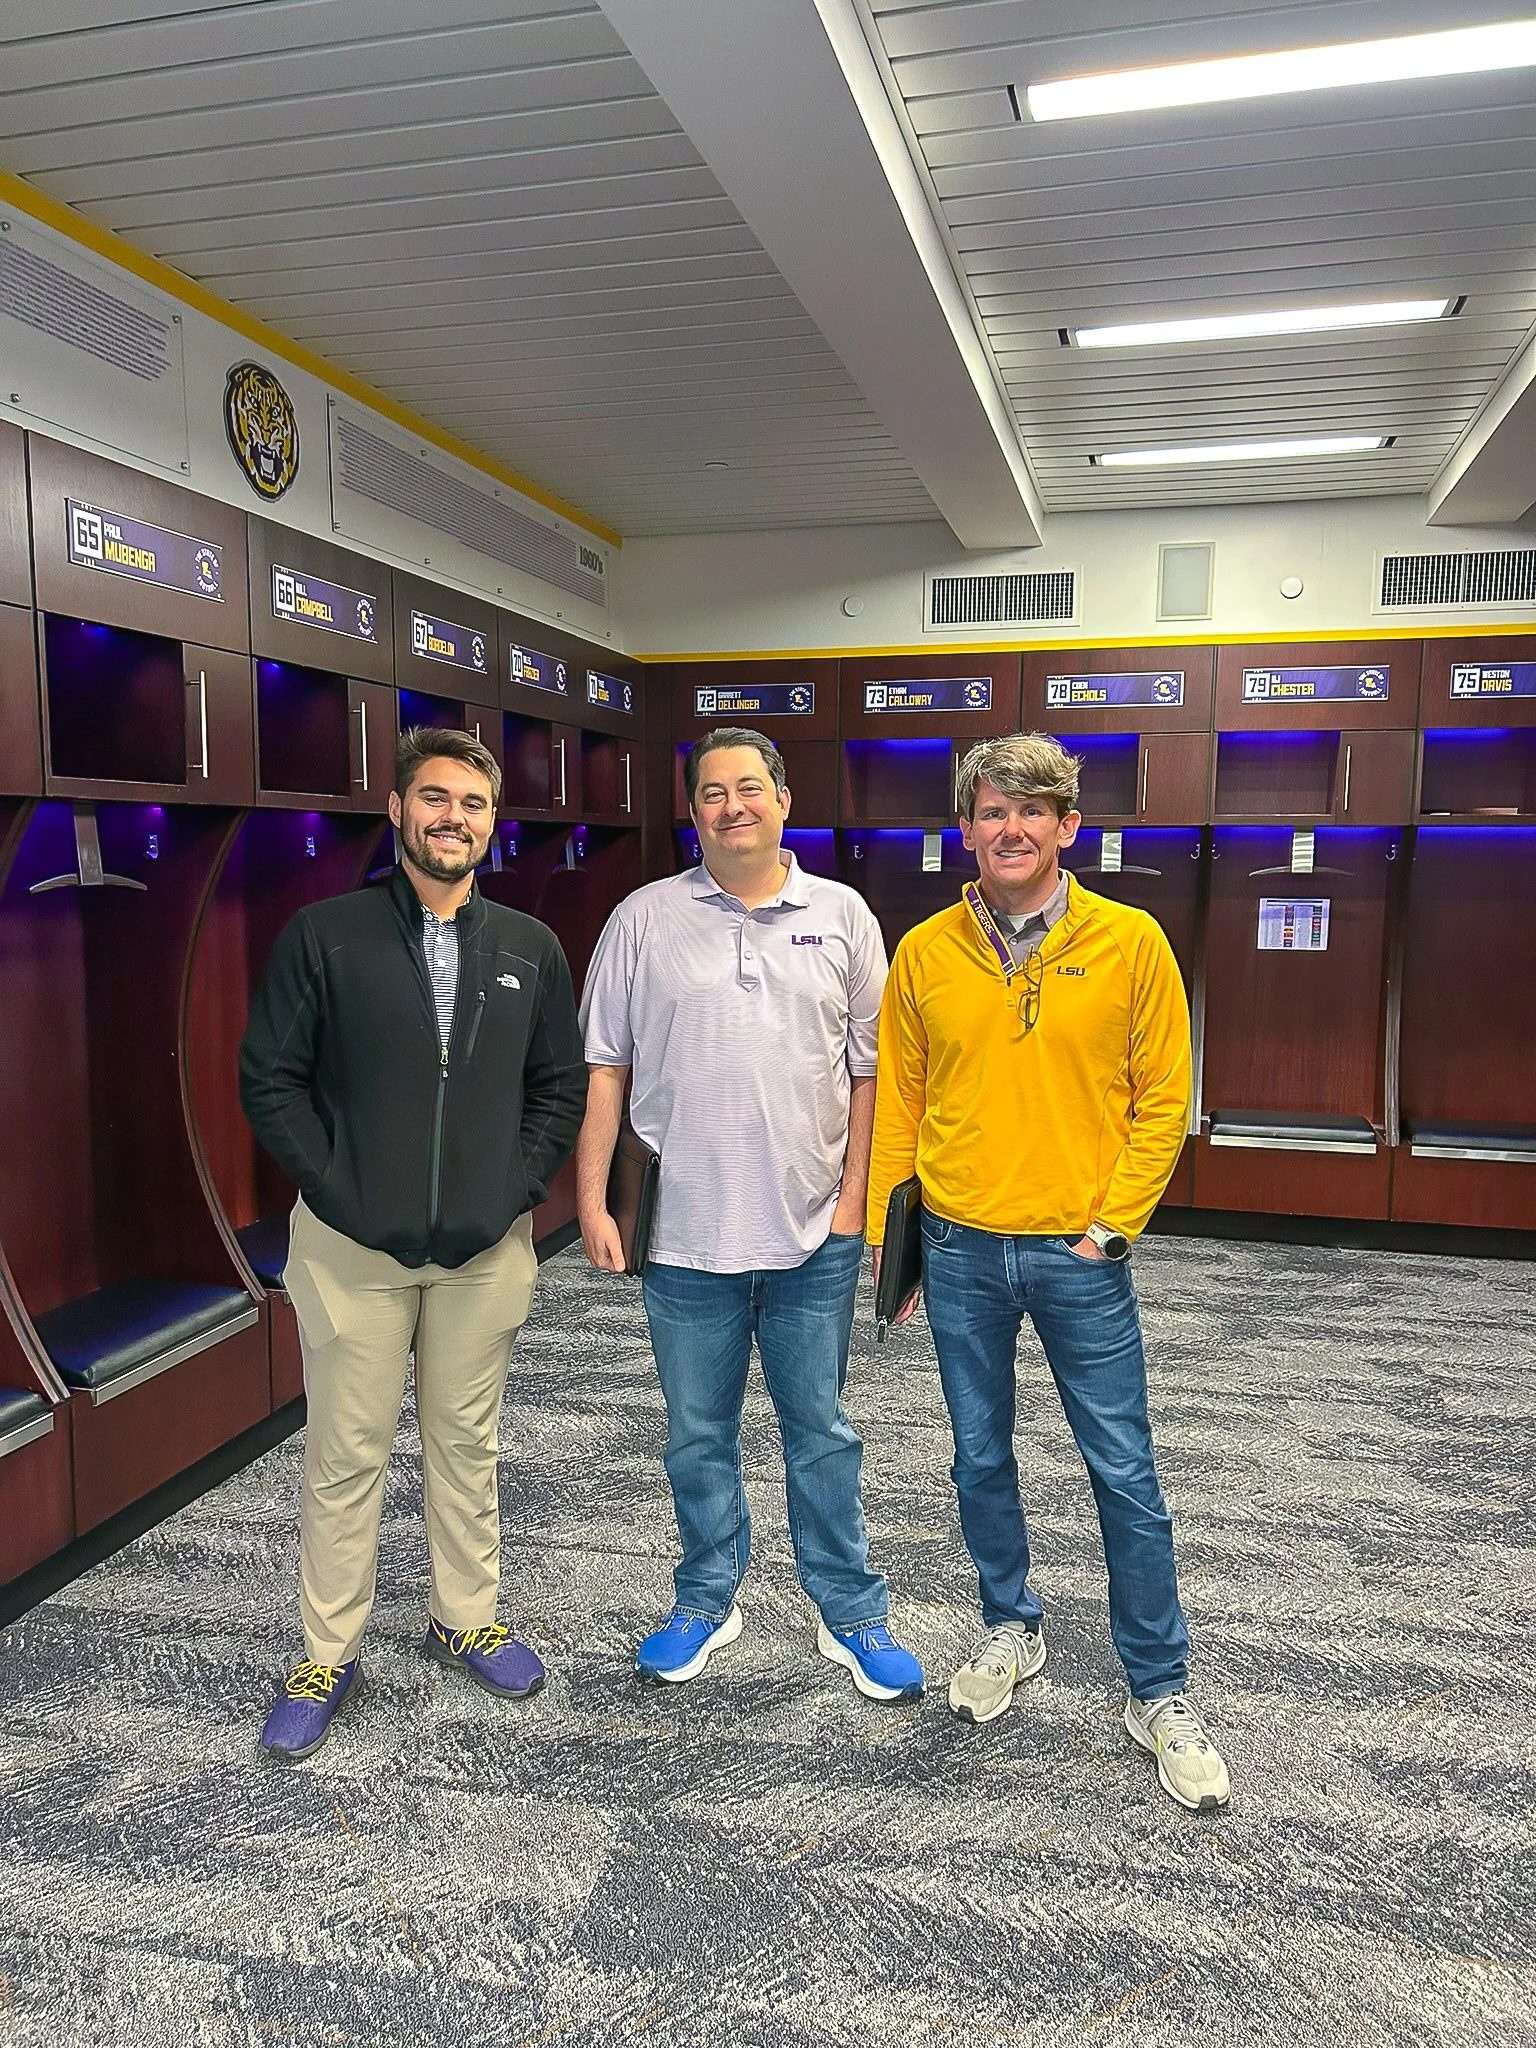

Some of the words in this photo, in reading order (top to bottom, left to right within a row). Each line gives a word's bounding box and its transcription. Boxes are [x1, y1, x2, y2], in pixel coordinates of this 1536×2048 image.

[77, 517, 98, 550] 65
[104, 521, 124, 541] PAUL
[105, 539, 156, 572] MUBENGA
[278, 579, 293, 605] 66
[296, 596, 333, 622] CAMPBELL
[416, 623, 425, 645] 67
[1249, 678, 1266, 692] 79
[1458, 673, 1477, 688] 75
[1481, 679, 1512, 692] DAVIS
[869, 689, 884, 704] 73
[889, 687, 907, 695] ETHAN
[1051, 684, 1067, 699] 78
[1072, 690, 1107, 702] ECHOLS
[1271, 683, 1314, 696] CHESTER
[700, 694, 714, 708] 72
[718, 699, 759, 711] DELLINGER
[889, 695, 932, 707] CALLOWAY
[792, 935, 822, 946] LSU
[1057, 966, 1085, 976] LSU
